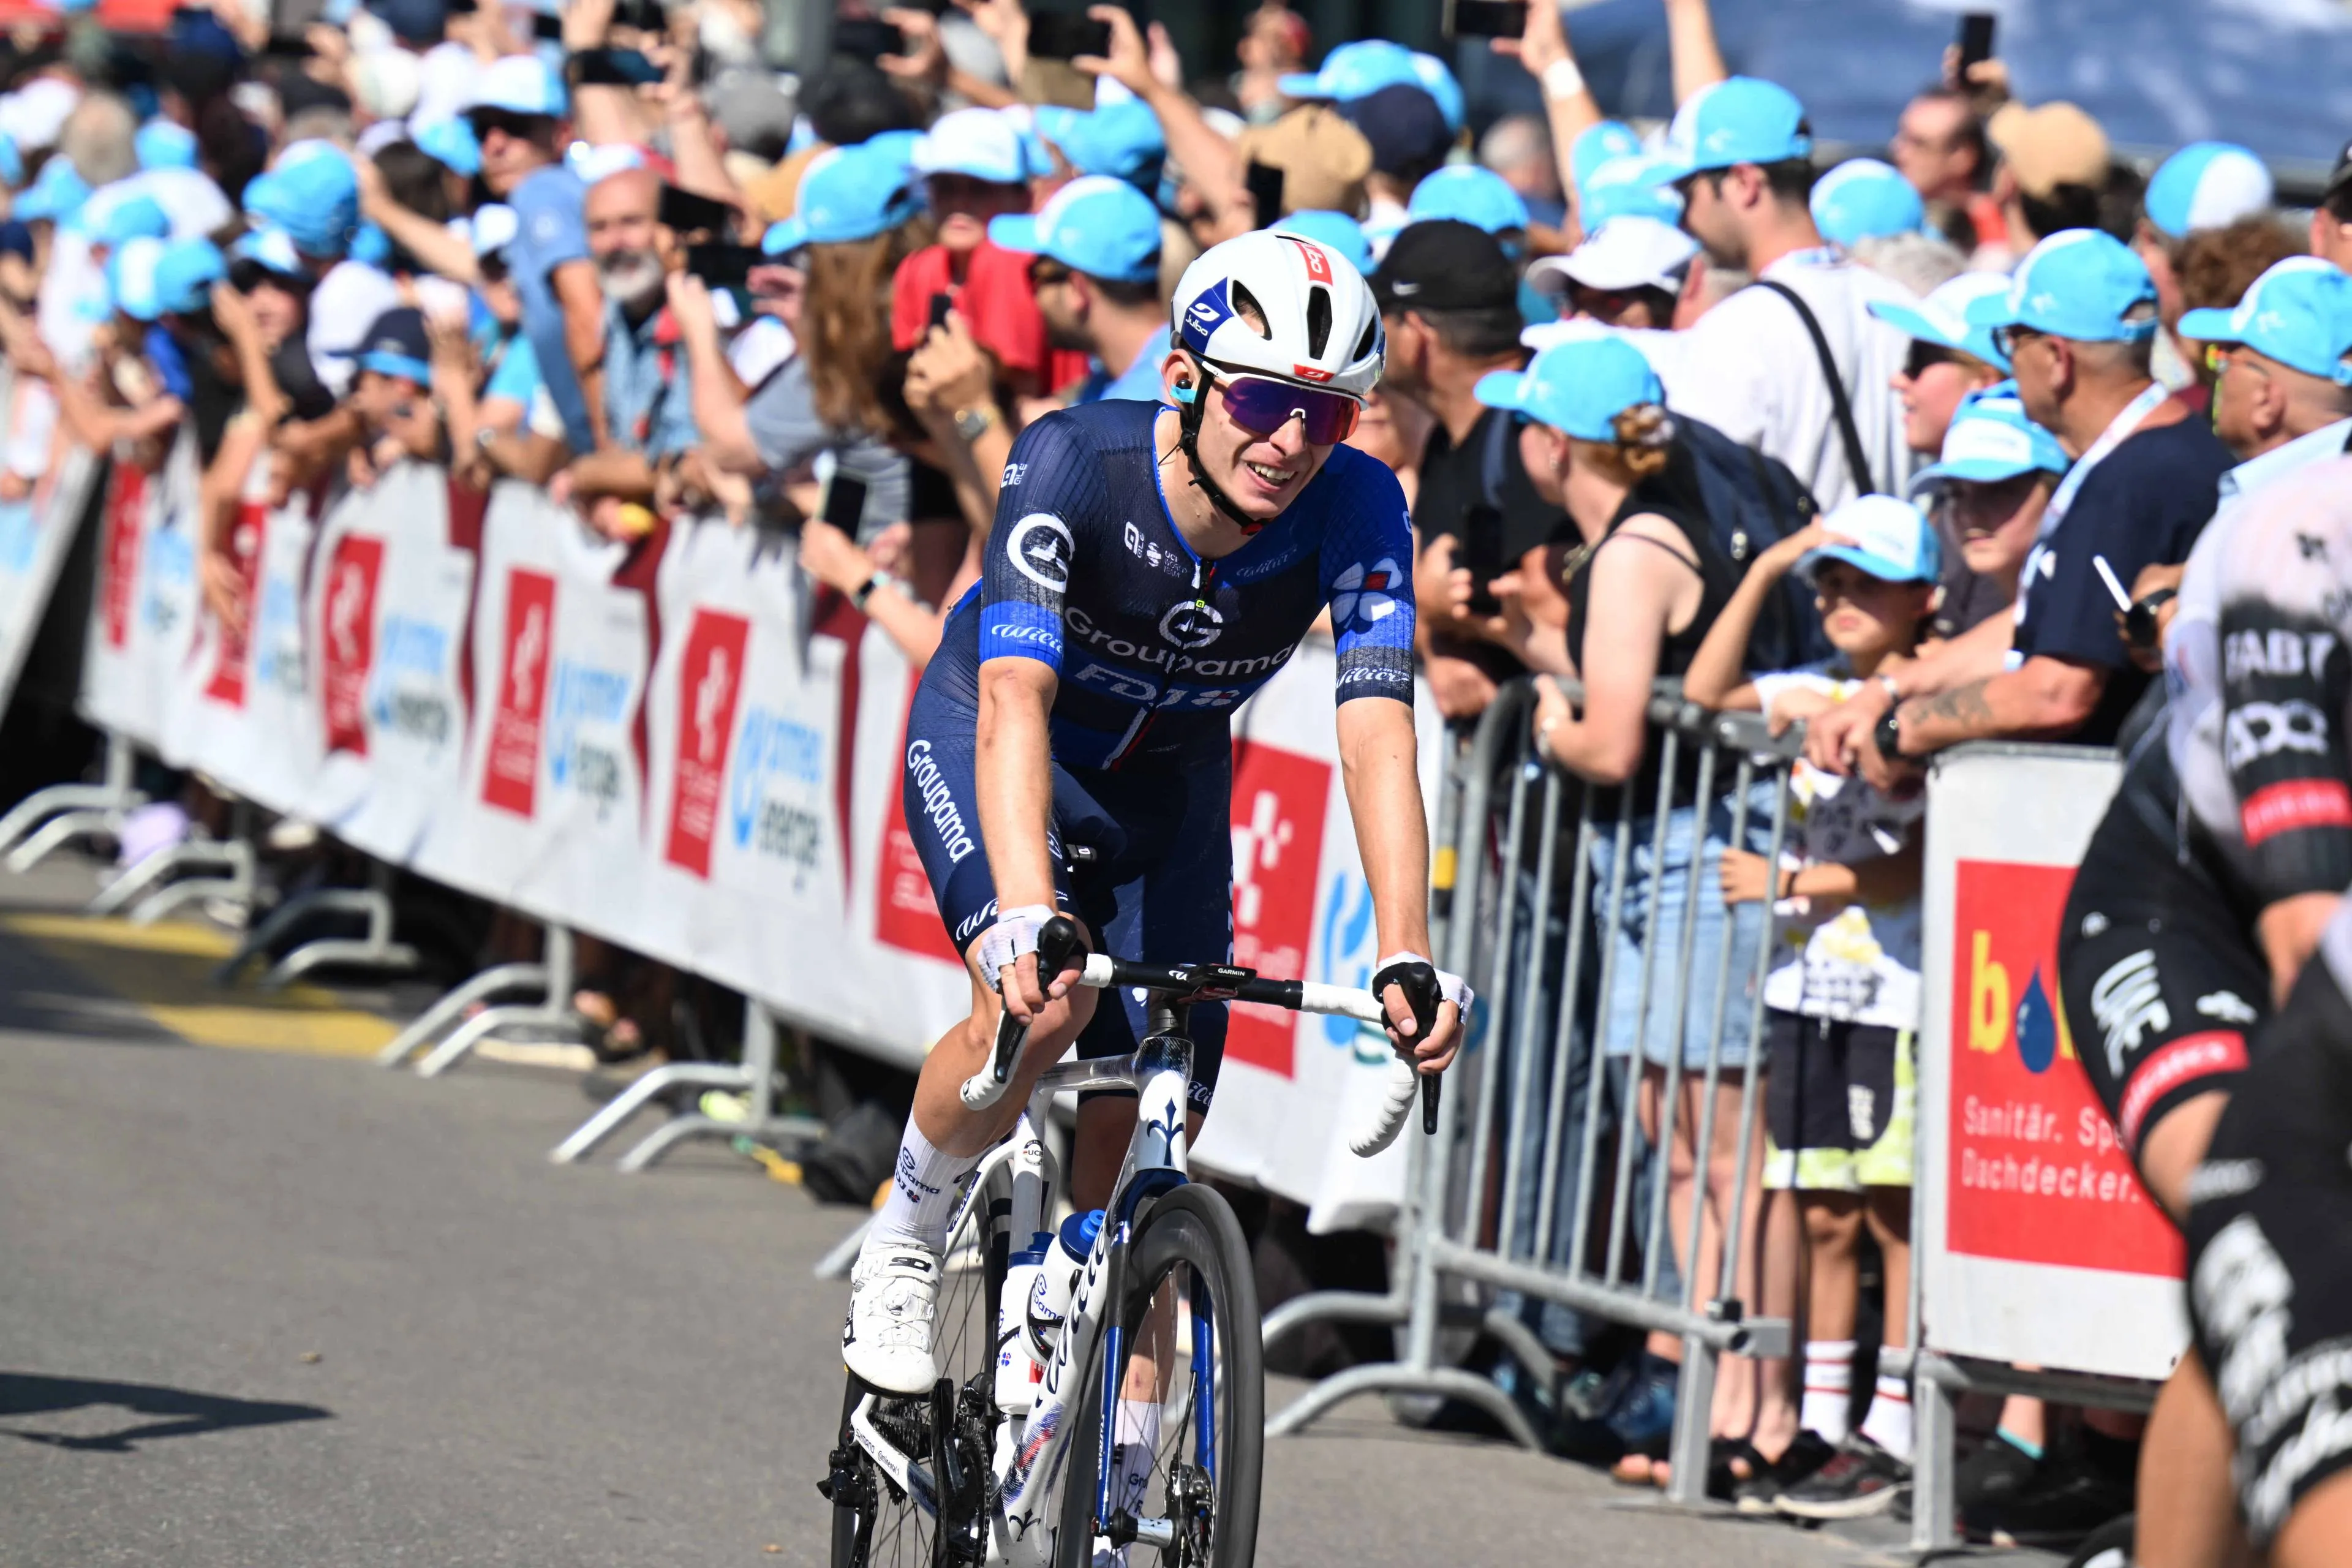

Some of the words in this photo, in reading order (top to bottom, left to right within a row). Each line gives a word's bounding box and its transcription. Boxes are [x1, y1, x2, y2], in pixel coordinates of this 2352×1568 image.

[1185, 314, 1208, 336] Julbo
[1165, 550, 1177, 562] UCI
[1064, 606, 1295, 676] Groupama
[1074, 663, 1188, 709] FDJ
[908, 739, 975, 864] Groupama
[1218, 968, 1246, 977] GARMIN
[1963, 1095, 2064, 1144] Sanitär.
[1962, 1147, 2141, 1204] Dachdecker.
[856, 1428, 875, 1455] SHIMANO
